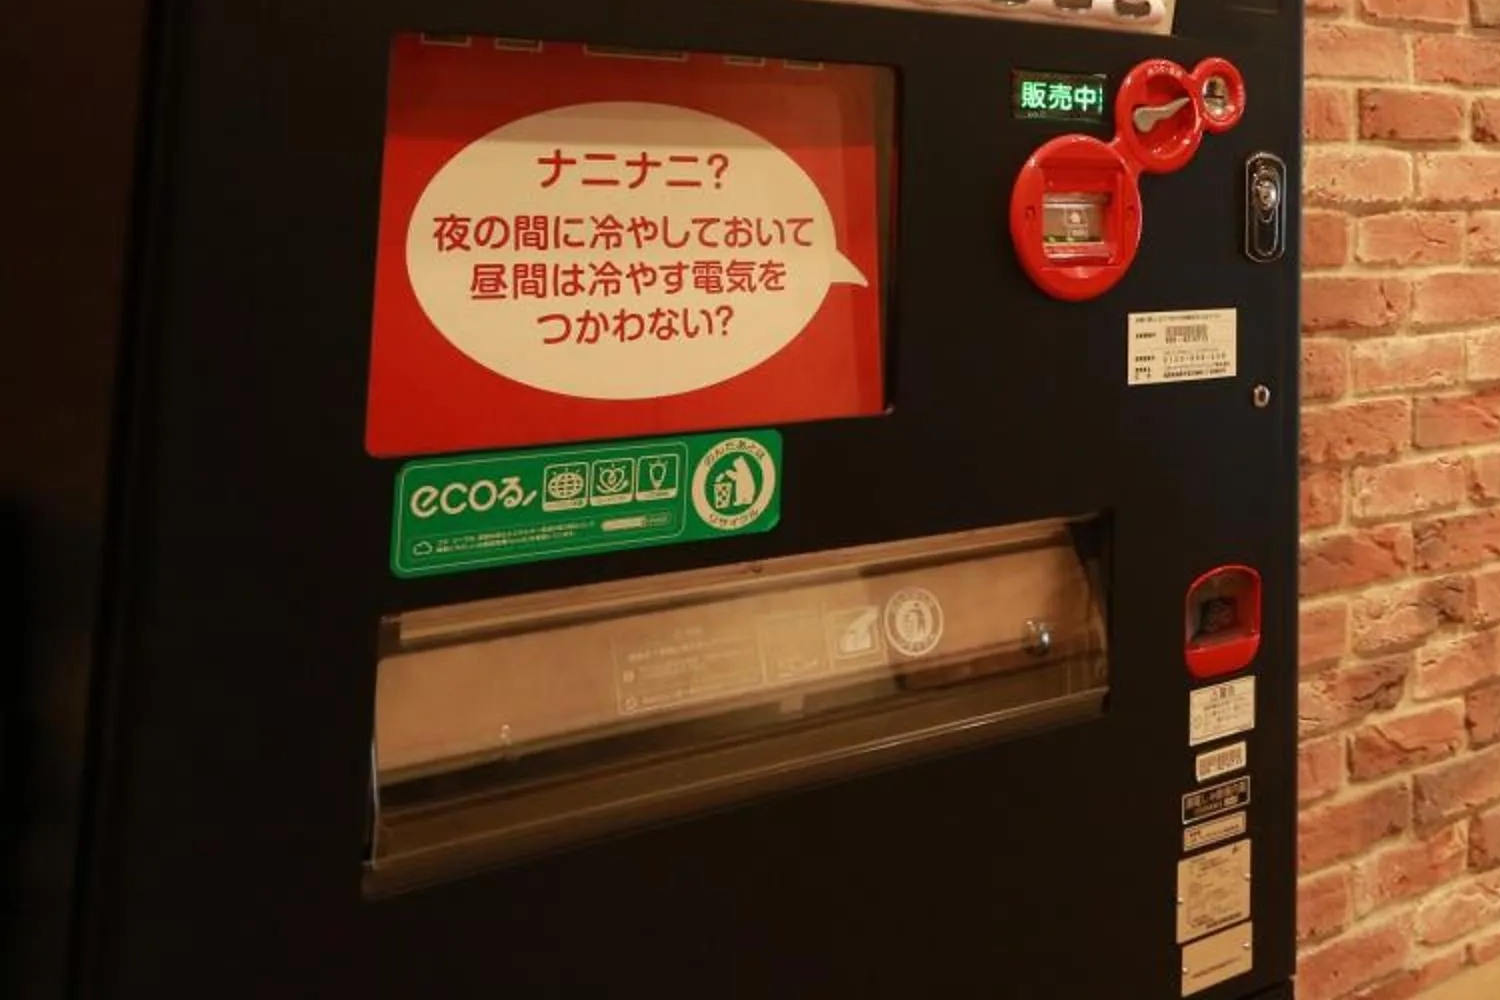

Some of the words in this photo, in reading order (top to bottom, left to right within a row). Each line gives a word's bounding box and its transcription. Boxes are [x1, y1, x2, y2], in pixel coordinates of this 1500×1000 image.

[1021, 81, 1097, 111] 販売中
[537, 149, 730, 190] ナニナニ?
[432, 213, 816, 252] 夜の間に冷やしておいて
[469, 260, 787, 300] 昼間は冷やす電気を
[536, 306, 735, 345] つかわない?
